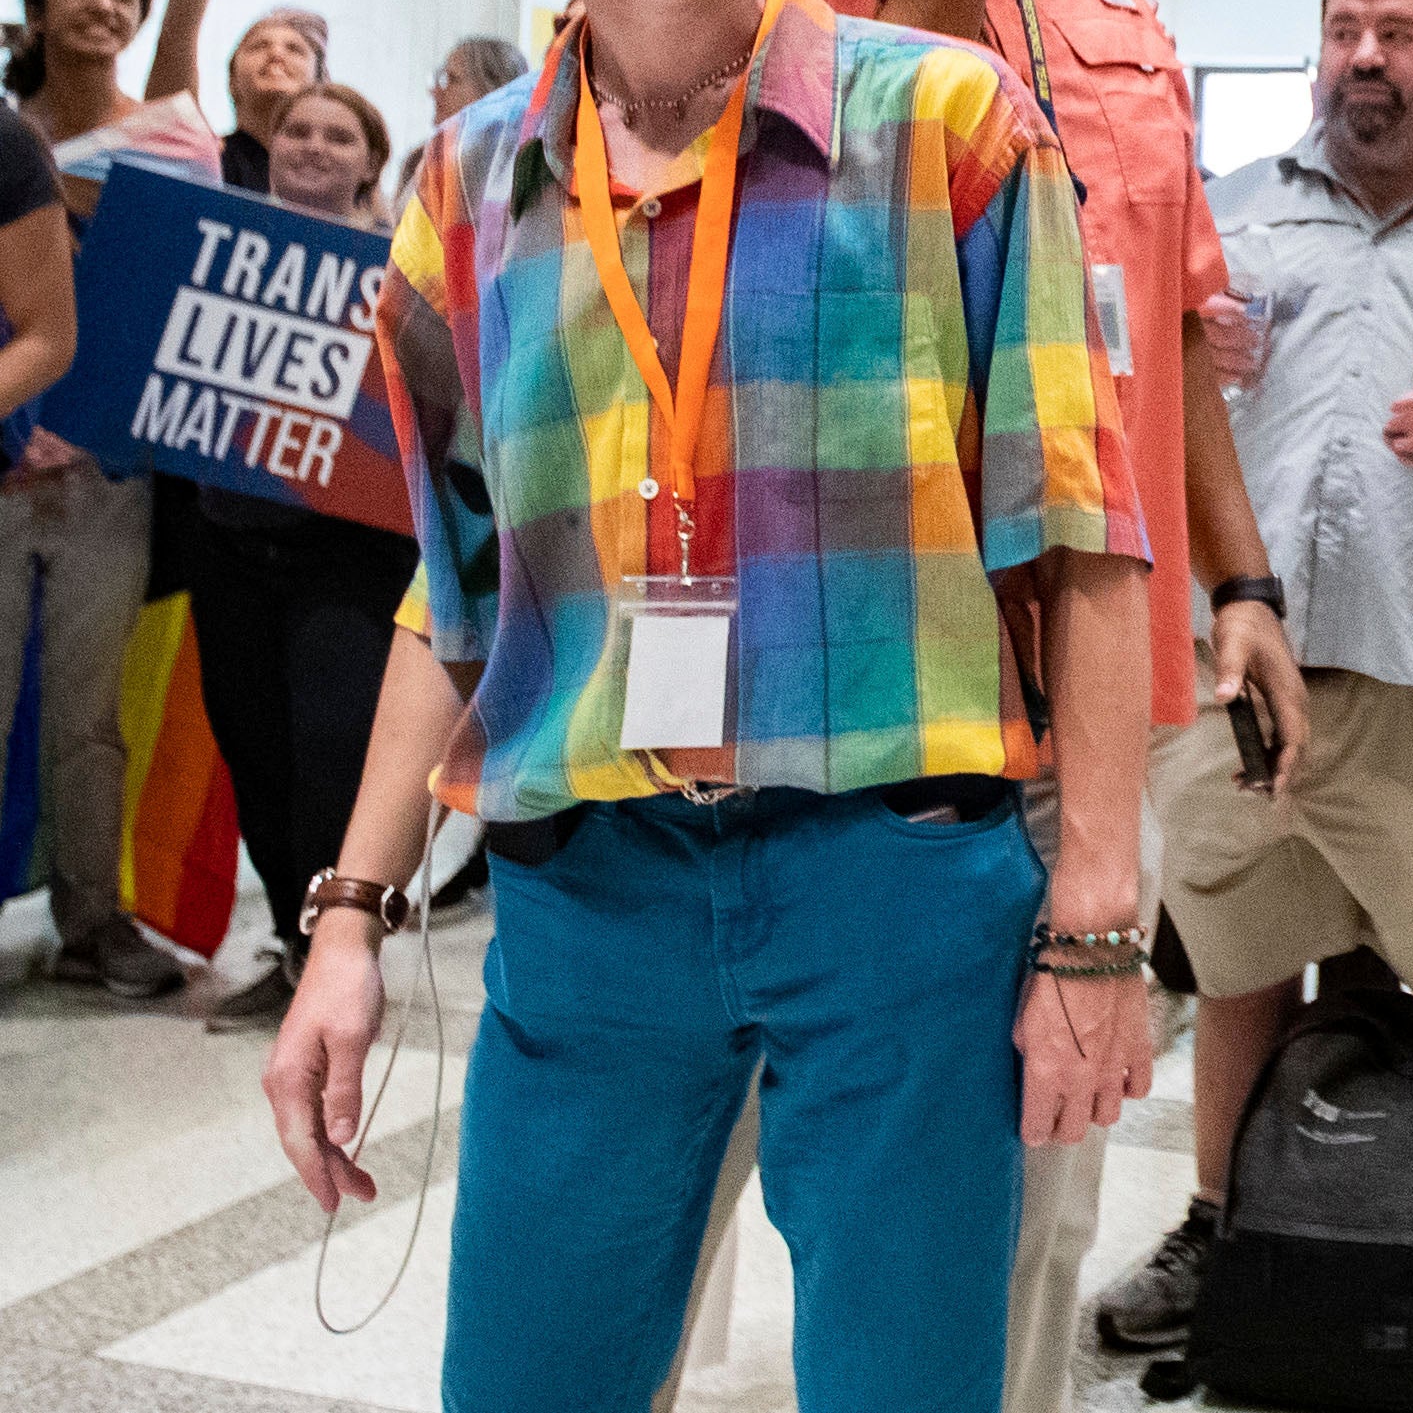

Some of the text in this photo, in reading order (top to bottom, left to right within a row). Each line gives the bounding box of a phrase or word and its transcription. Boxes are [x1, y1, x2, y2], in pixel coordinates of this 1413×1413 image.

[191, 218, 386, 332] TRANS
[177, 300, 351, 400] LIVES
[130, 375, 344, 487] MATTER
